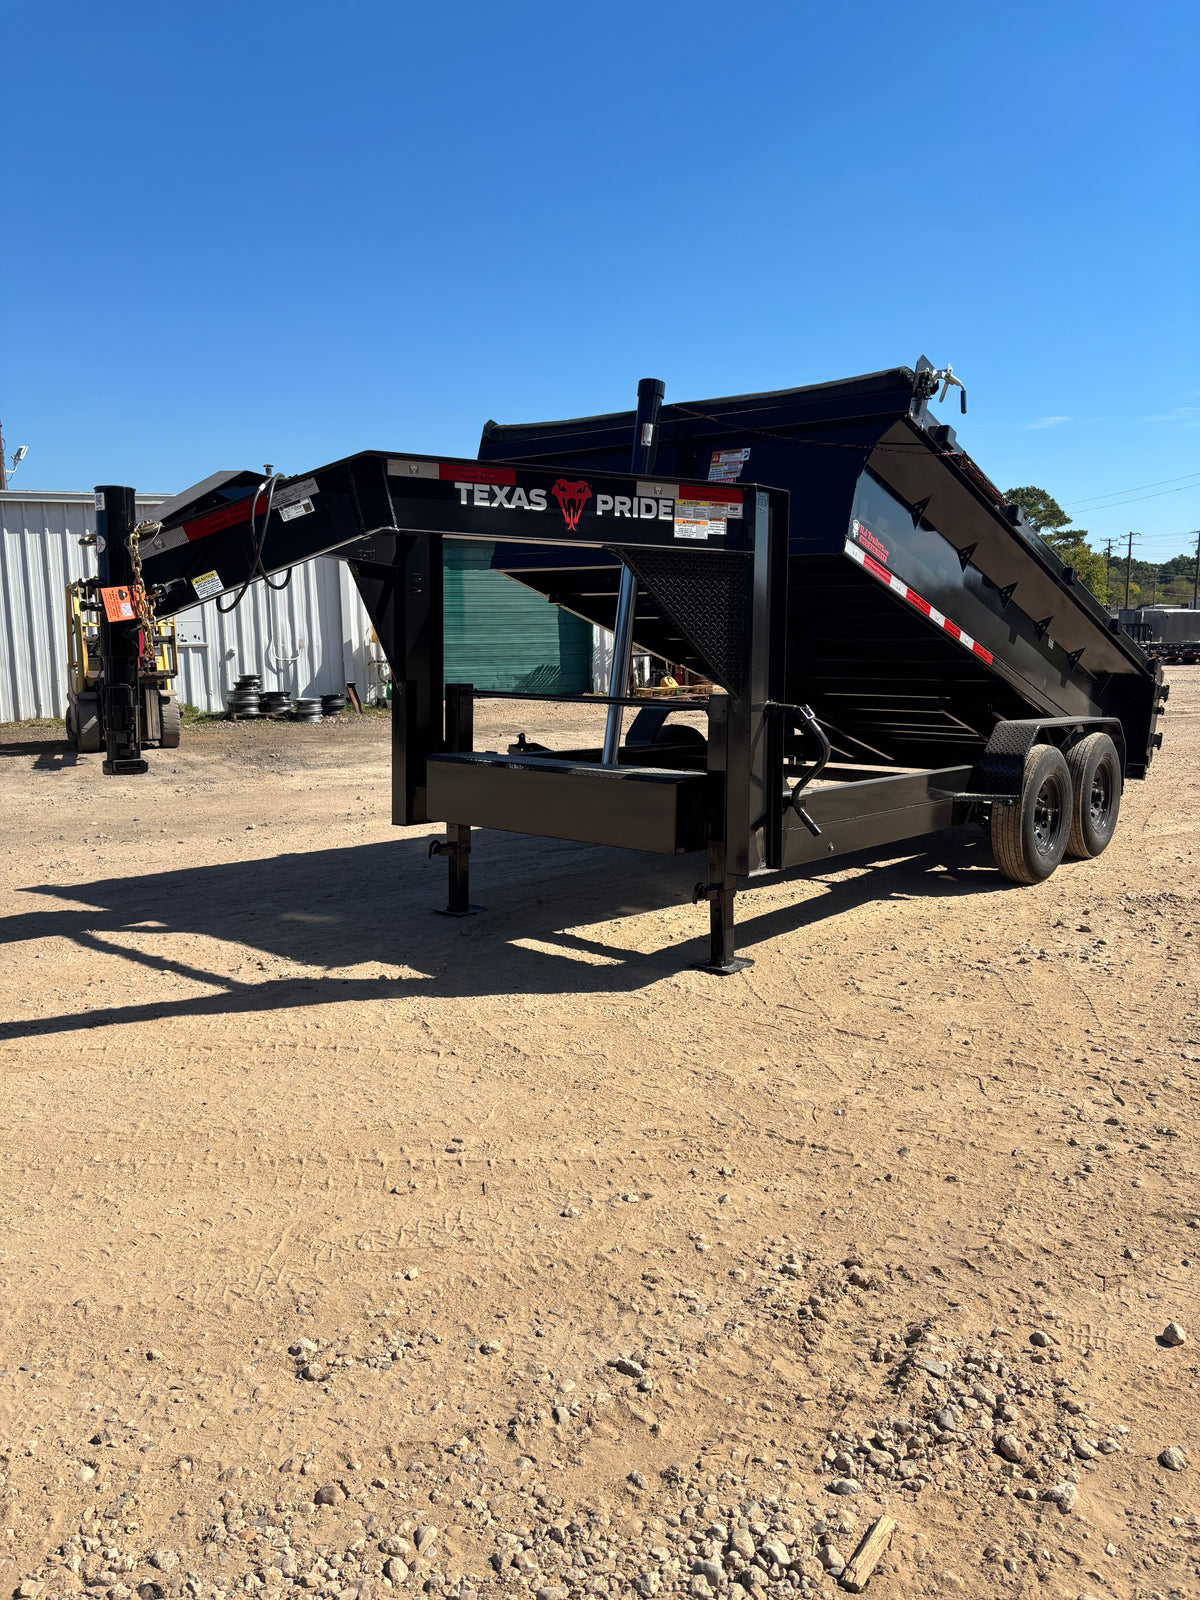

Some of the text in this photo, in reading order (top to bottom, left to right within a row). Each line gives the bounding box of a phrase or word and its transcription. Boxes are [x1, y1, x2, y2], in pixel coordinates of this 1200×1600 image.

[455, 482, 547, 511] TEXAS
[596, 494, 673, 521] PRIDE
[197, 572, 215, 582] CAUTION
